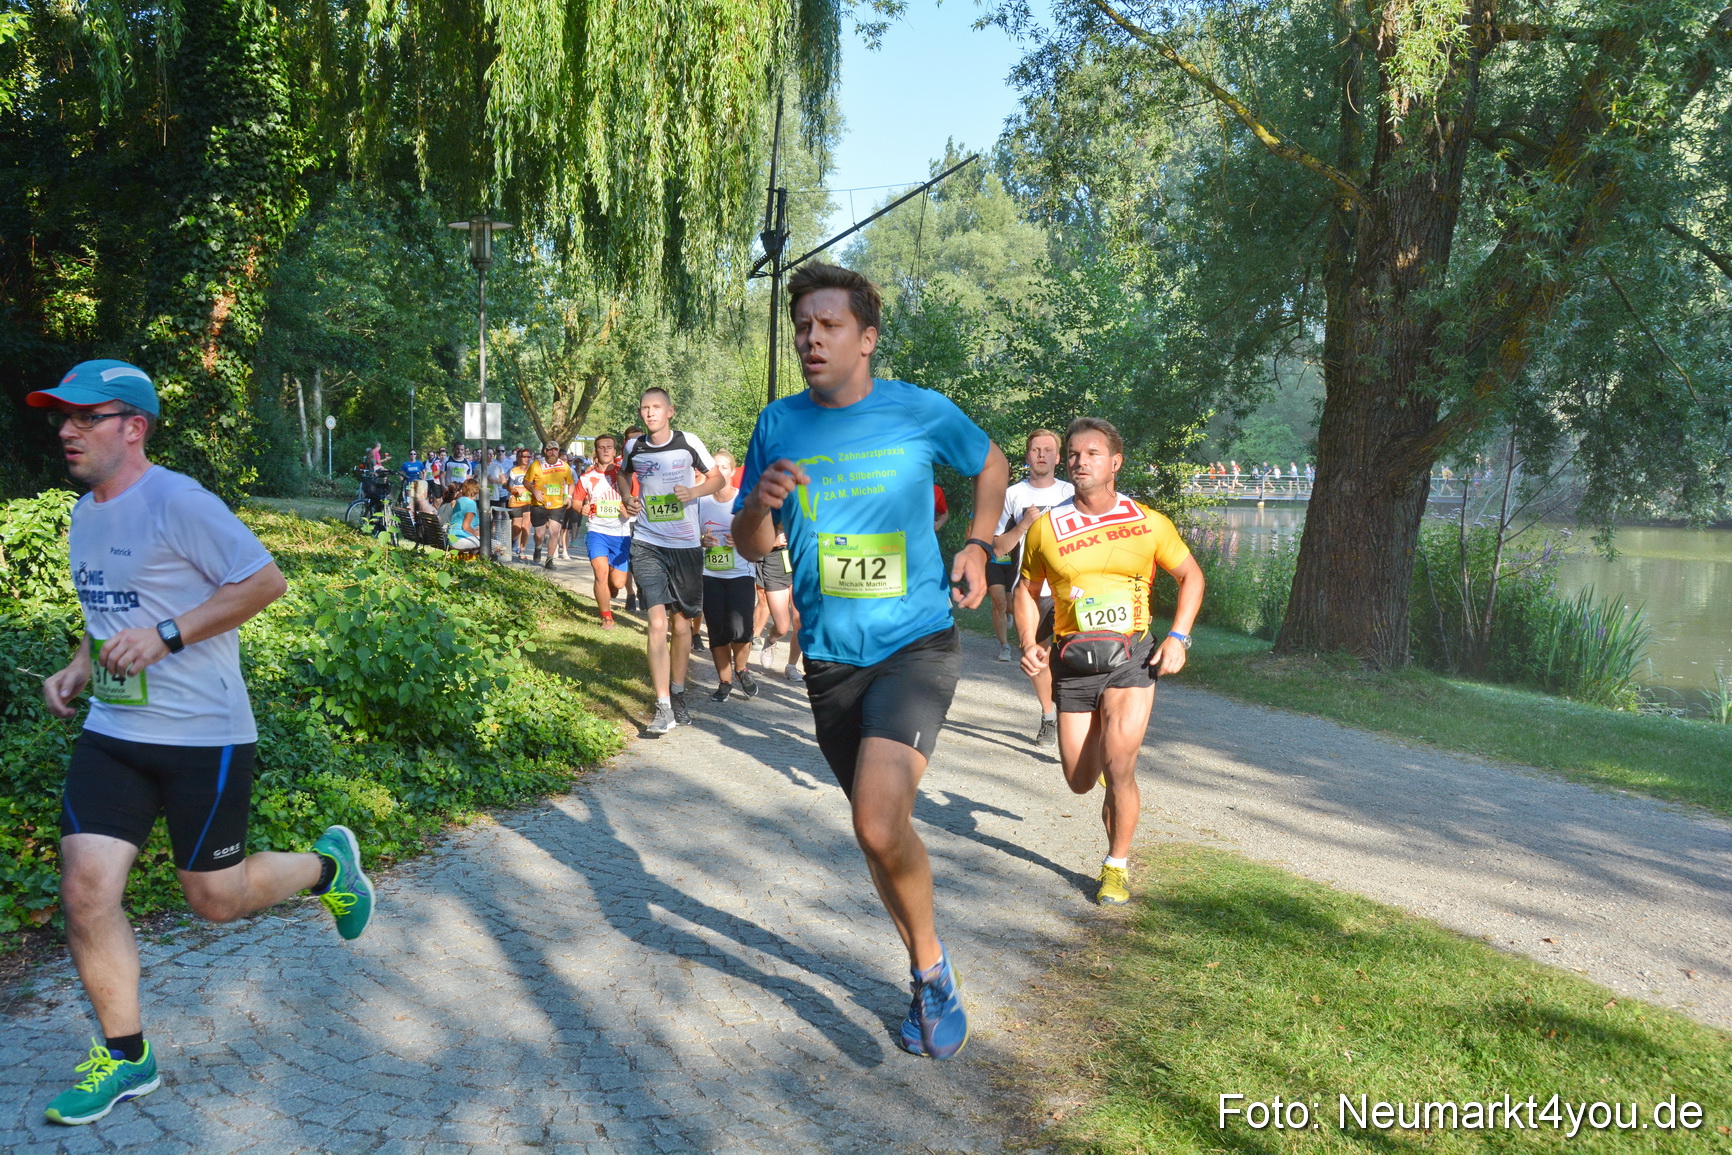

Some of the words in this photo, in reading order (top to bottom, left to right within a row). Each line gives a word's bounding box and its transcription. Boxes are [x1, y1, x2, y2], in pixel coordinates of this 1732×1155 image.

[838, 446, 904, 461] Zahnarztpraxis
[822, 476, 835, 486] Dr.
[837, 474, 847, 483] R.
[849, 469, 897, 481] Silberhorn
[824, 491, 837, 501] ZA
[838, 489, 850, 498] M.
[851, 484, 886, 497] Michalk
[651, 503, 678, 515] 1475
[1058, 534, 1102, 557] MAX
[1105, 524, 1152, 541] BÖGL
[110, 547, 132, 557] Patrick
[707, 554, 729, 563] 1821
[837, 557, 886, 580] 712
[1084, 606, 1127, 627] 1203
